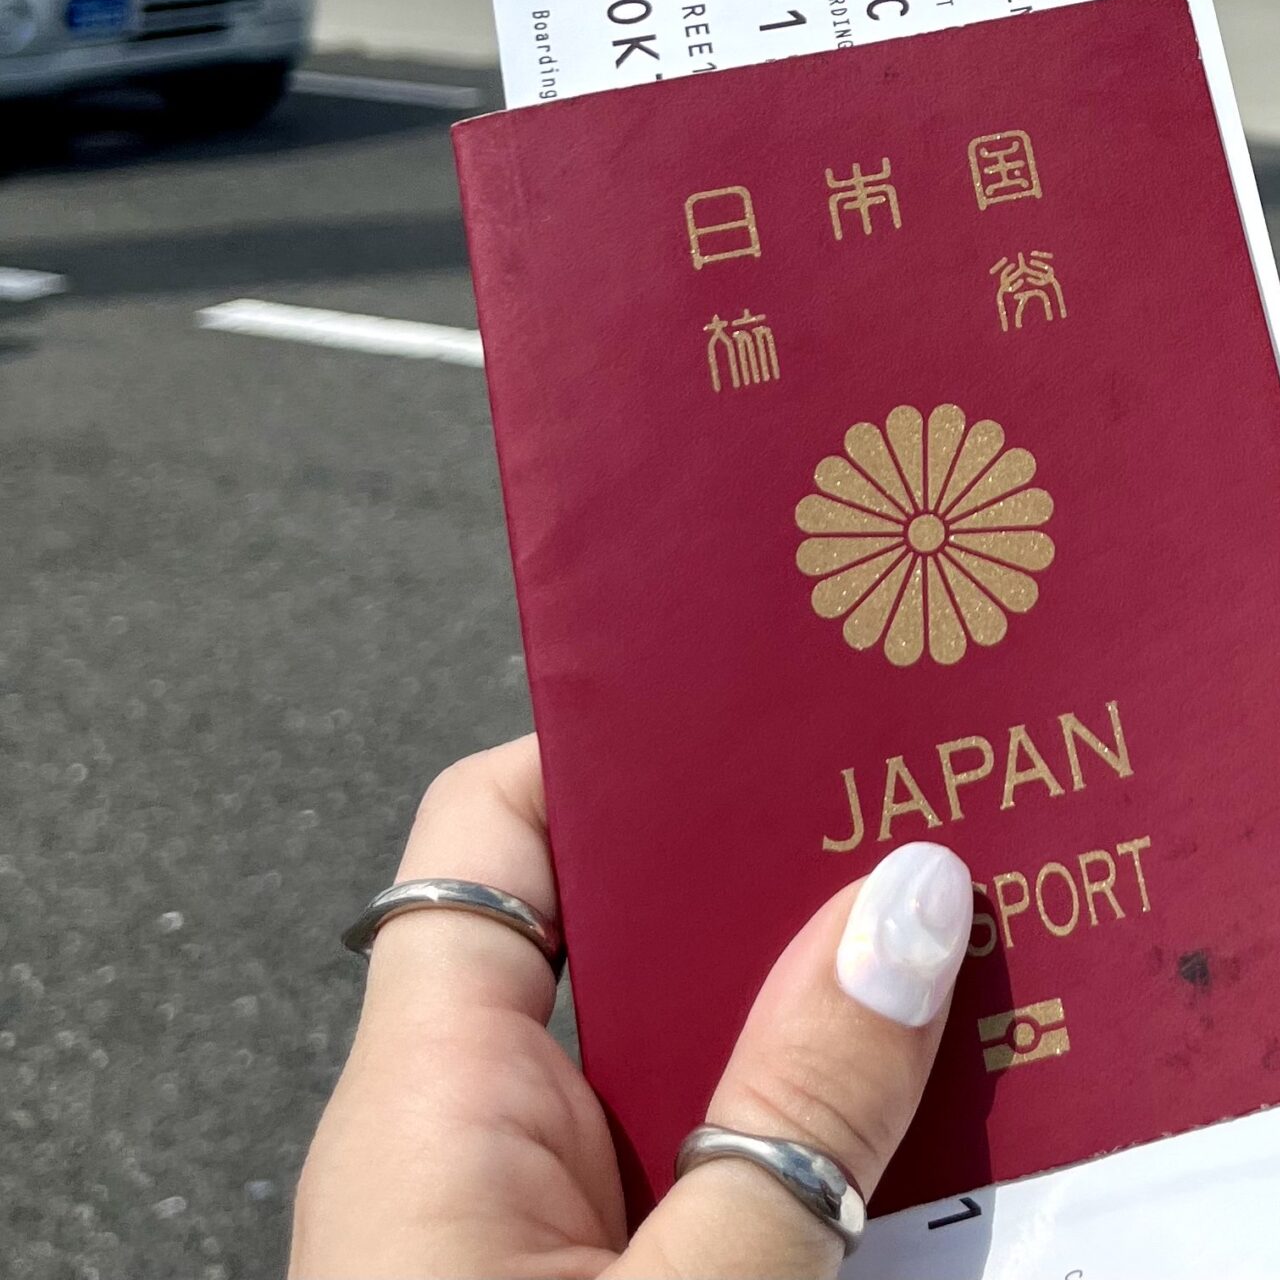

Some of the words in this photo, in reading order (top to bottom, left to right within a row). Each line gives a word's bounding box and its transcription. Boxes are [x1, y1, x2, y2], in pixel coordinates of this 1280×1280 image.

[532, 9, 559, 100] Boarding
[684, 129, 1043, 270] 日本国
[822, 700, 1135, 853] JAPAN
